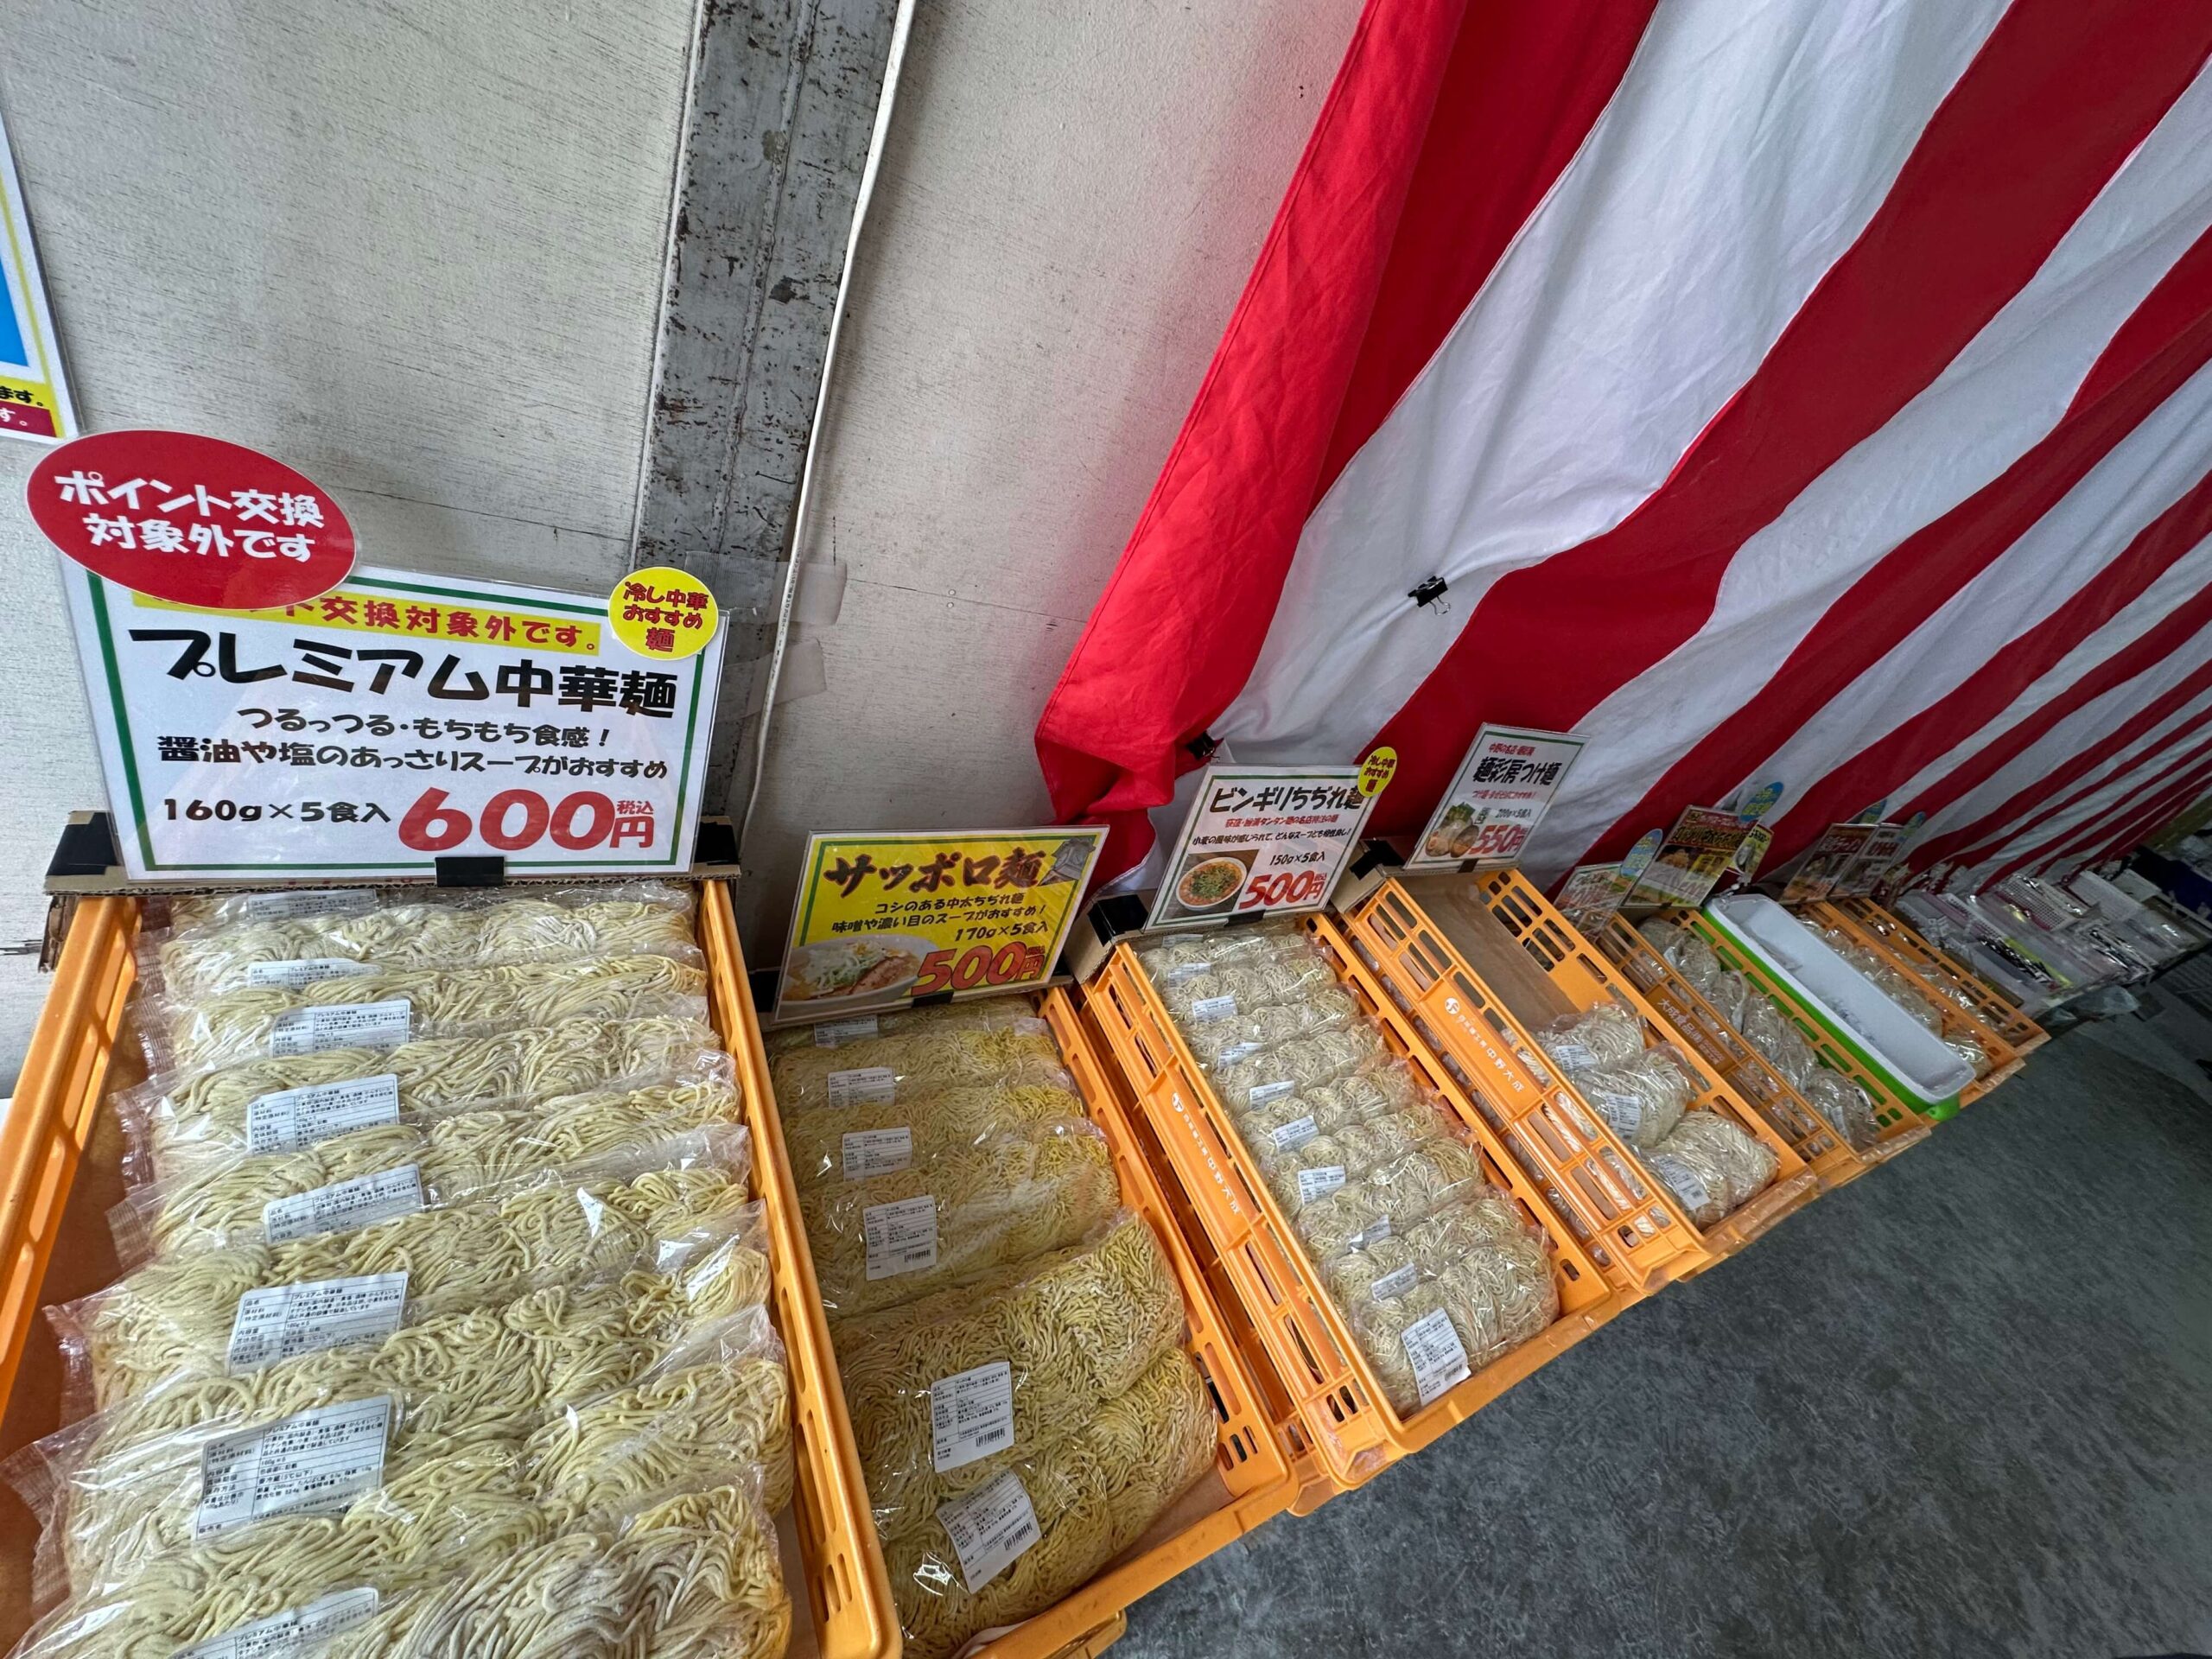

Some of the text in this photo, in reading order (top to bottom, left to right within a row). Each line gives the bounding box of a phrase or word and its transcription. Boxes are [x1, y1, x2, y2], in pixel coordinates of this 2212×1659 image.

[54, 469, 326, 529] ポイント交換
[85, 514, 317, 564] 対象外です
[622, 581, 709, 611] 冷し中華
[250, 594, 596, 652] ト交換対象外です。
[622, 603, 703, 630] おすすめ
[645, 626, 676, 652] 麺
[127, 628, 678, 719] プレミアム中華麺
[157, 734, 669, 780] 醤油や塩のあっさりスープがおすすめ
[1472, 756, 1563, 786] 麺彩房つけ麺
[1209, 785, 1365, 814] ビンギリちぢれ麺
[823, 846, 1047, 899] サッポロ麺
[874, 892, 1026, 915] コシのある中太ちぢれ麺
